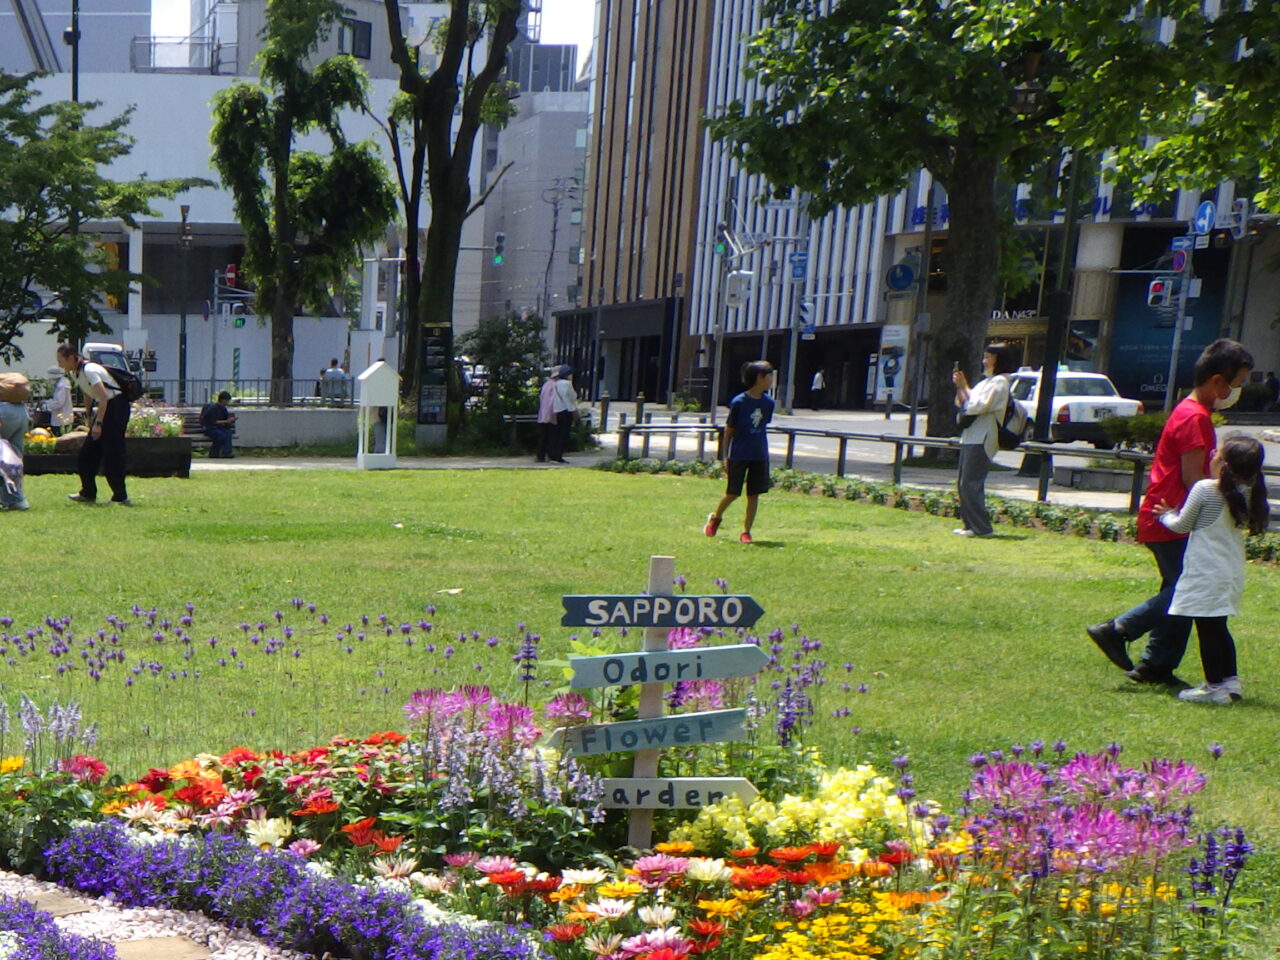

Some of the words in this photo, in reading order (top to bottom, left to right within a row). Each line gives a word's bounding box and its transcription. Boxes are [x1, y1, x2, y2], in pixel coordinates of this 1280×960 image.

[1140, 384, 1168, 392] OMEG
[584, 597, 743, 625] SAPPORO
[603, 655, 703, 684] Odori
[580, 719, 714, 753] Flower
[602, 782, 725, 806] arden
